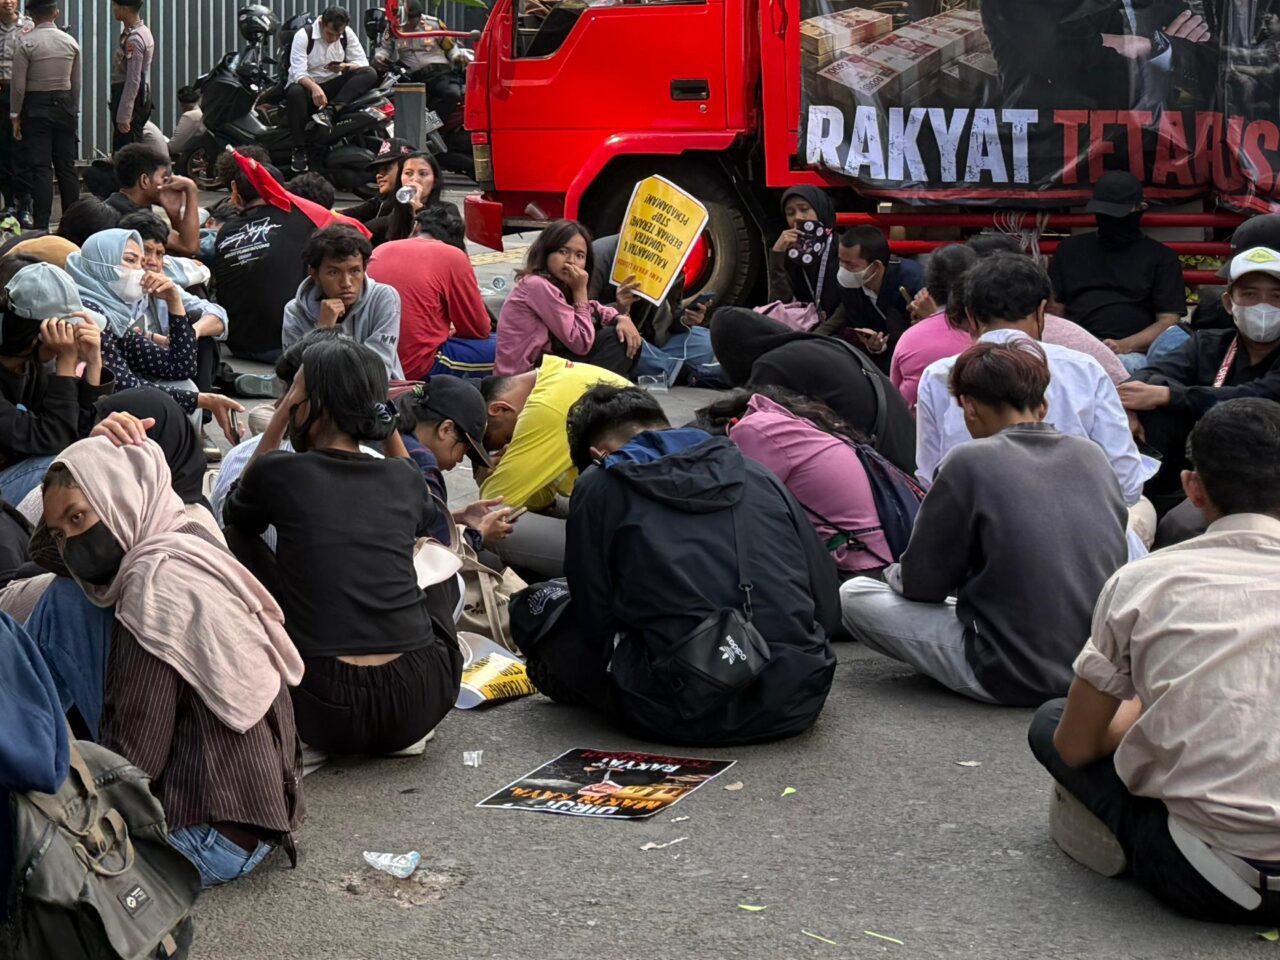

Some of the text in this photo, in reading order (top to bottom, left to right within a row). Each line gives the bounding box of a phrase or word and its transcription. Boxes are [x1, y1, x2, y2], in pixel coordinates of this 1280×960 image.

[806, 105, 1039, 184] RAKYAT
[644, 193, 690, 226] PEMADAMAN!
[651, 212, 671, 228] STOP
[634, 231, 666, 254] SUMATRA
[656, 228, 684, 250] BERHAK
[725, 634, 747, 661] adidas
[590, 757, 681, 773] RAKYAT
[576, 794, 662, 810] MAKIN
